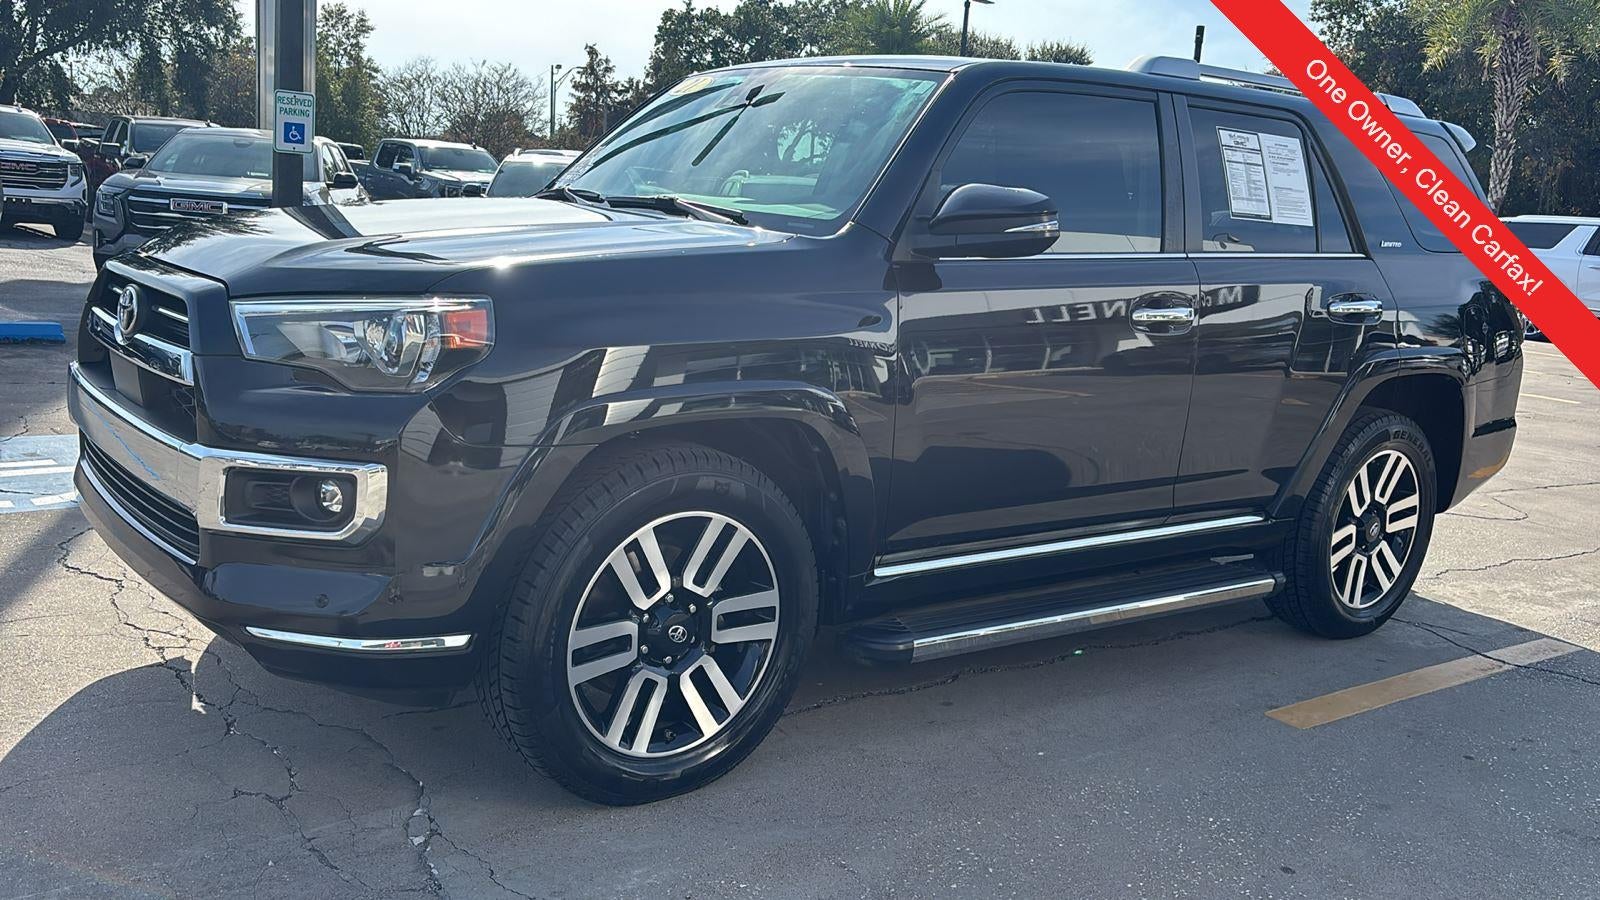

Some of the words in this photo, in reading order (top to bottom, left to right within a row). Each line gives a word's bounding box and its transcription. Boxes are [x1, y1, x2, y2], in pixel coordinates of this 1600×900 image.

[277, 96, 313, 108] RESERVED
[279, 106, 310, 118] PARKING
[172, 200, 223, 213] GMC
[1392, 430, 1432, 468] GENERAL
